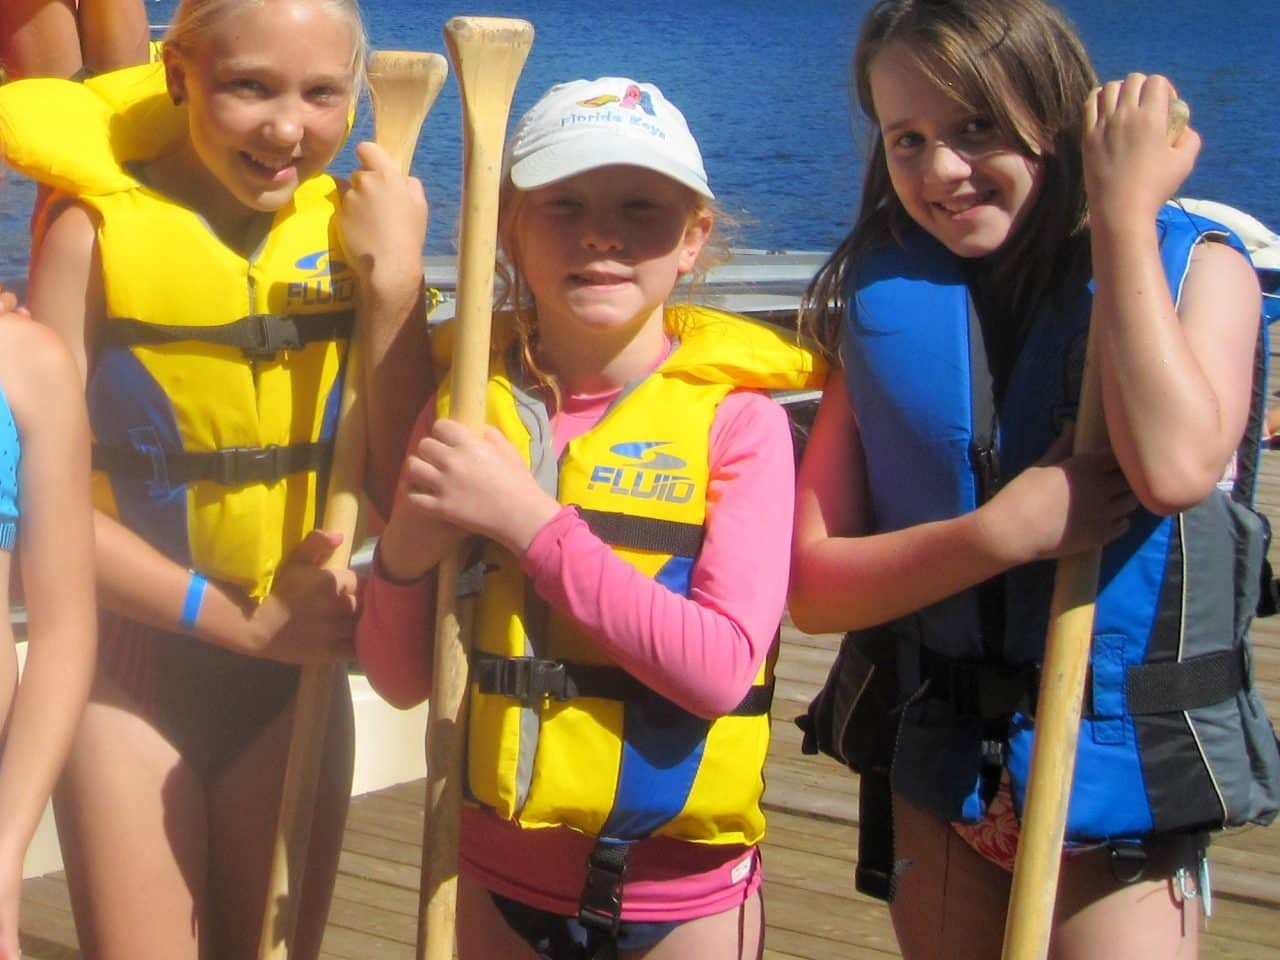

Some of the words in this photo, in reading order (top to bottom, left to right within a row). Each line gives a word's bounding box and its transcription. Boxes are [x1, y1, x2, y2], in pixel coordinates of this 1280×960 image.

[560, 110, 623, 128] Florida
[629, 114, 667, 140] Keys
[587, 465, 696, 504] FLUID
